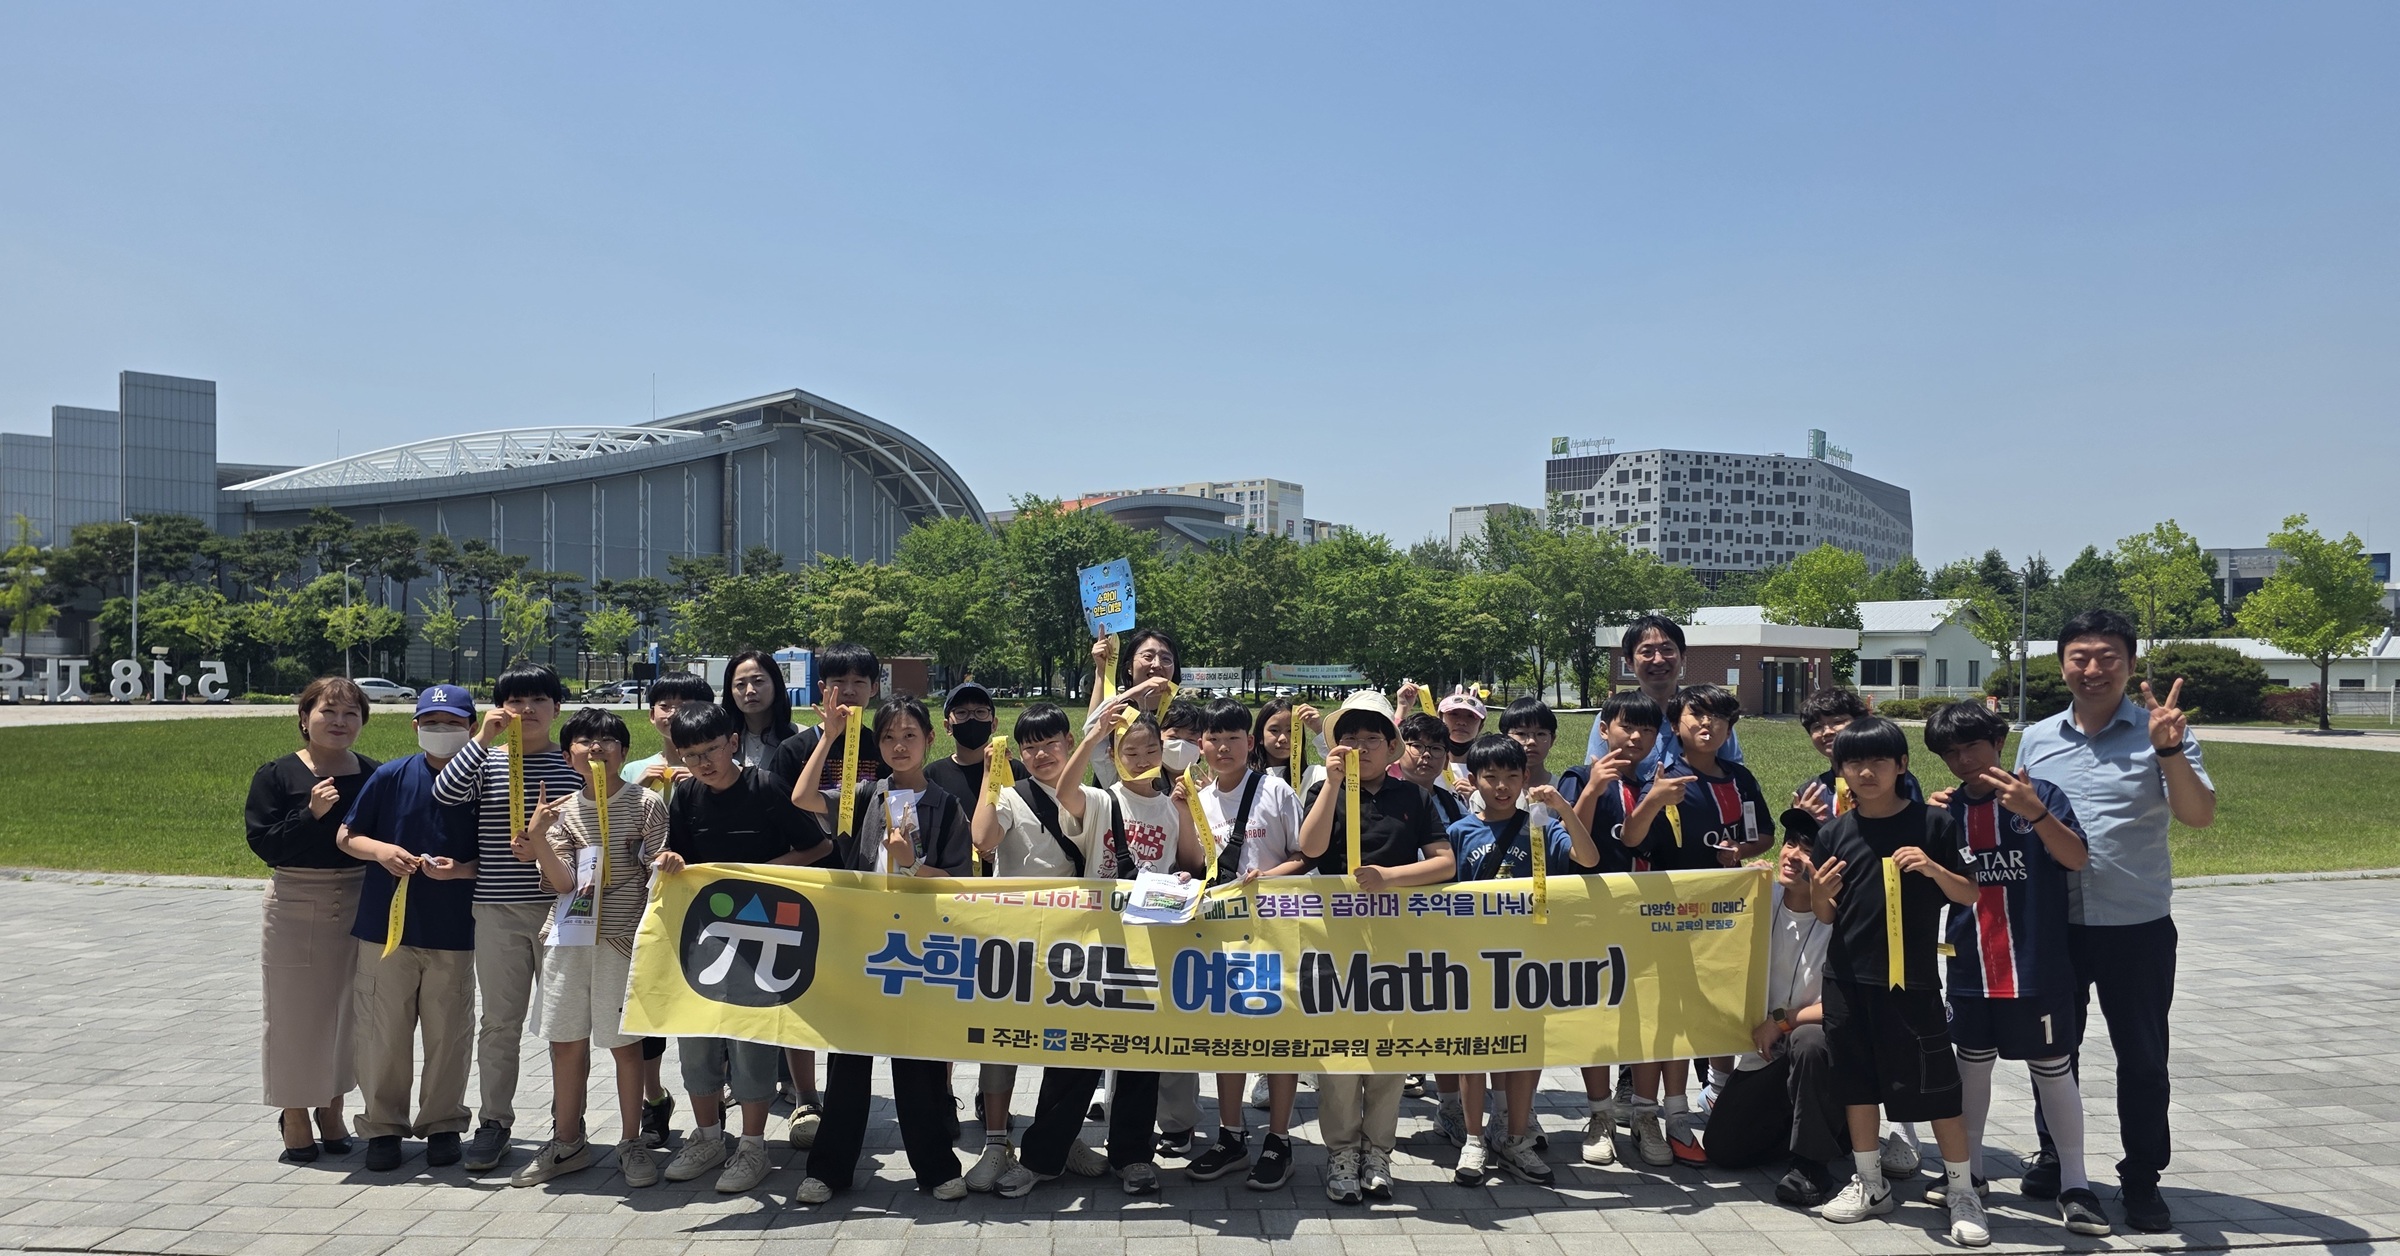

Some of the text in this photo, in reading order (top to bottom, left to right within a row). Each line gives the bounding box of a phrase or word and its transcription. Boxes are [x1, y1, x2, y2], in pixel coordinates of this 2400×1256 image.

[1256, 894, 1324, 918] 경험은
[1331, 893, 1399, 917] 곱하며
[1407, 893, 1475, 917] 추억을
[1640, 897, 1747, 918] 다양한 실력이 미래다
[1651, 918, 1737, 932] 다시, 교육의 본질로
[864, 931, 1628, 1015] 수학이 있는 여행 (Math Tour)
[991, 1027, 1528, 1058] 주관: 광주광역시교육청창의융합교육원 광주수학체험센터
[2040, 1013, 2053, 1045] 1
